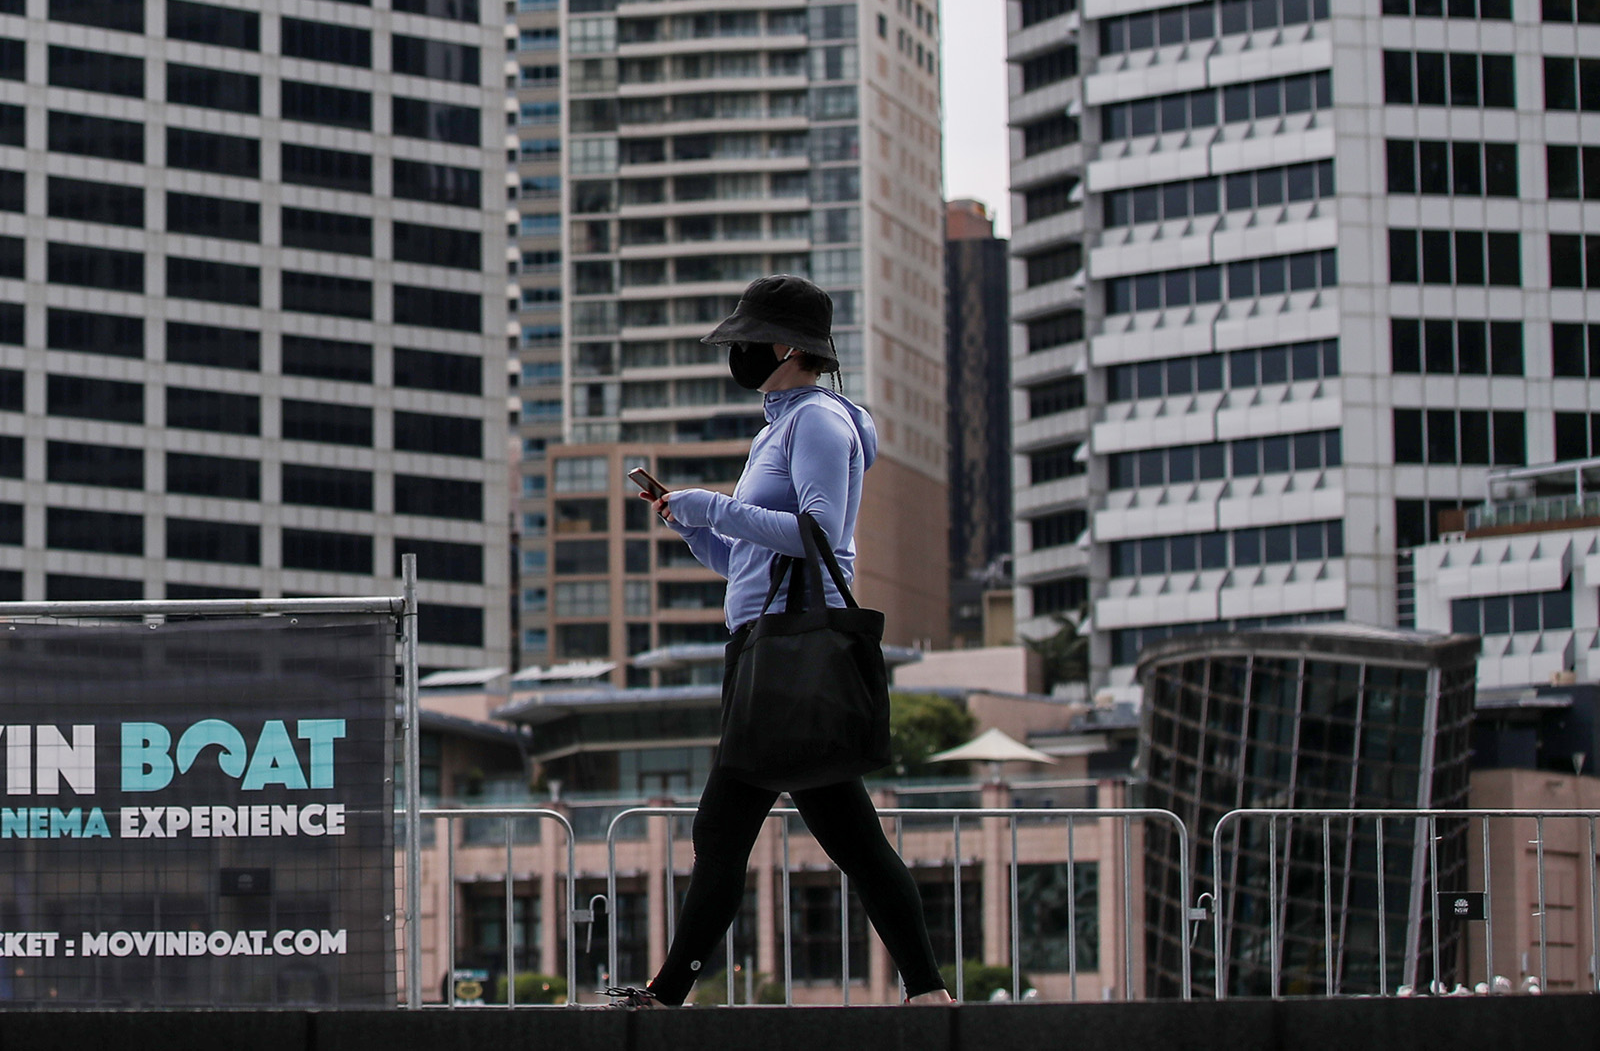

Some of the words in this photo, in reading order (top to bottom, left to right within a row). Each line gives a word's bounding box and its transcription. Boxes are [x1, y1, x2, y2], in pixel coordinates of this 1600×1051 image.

[121, 718, 346, 792] BOAT
[120, 803, 346, 838] EXPERIENCE
[81, 929, 347, 957] MOVINBOAT.COM
